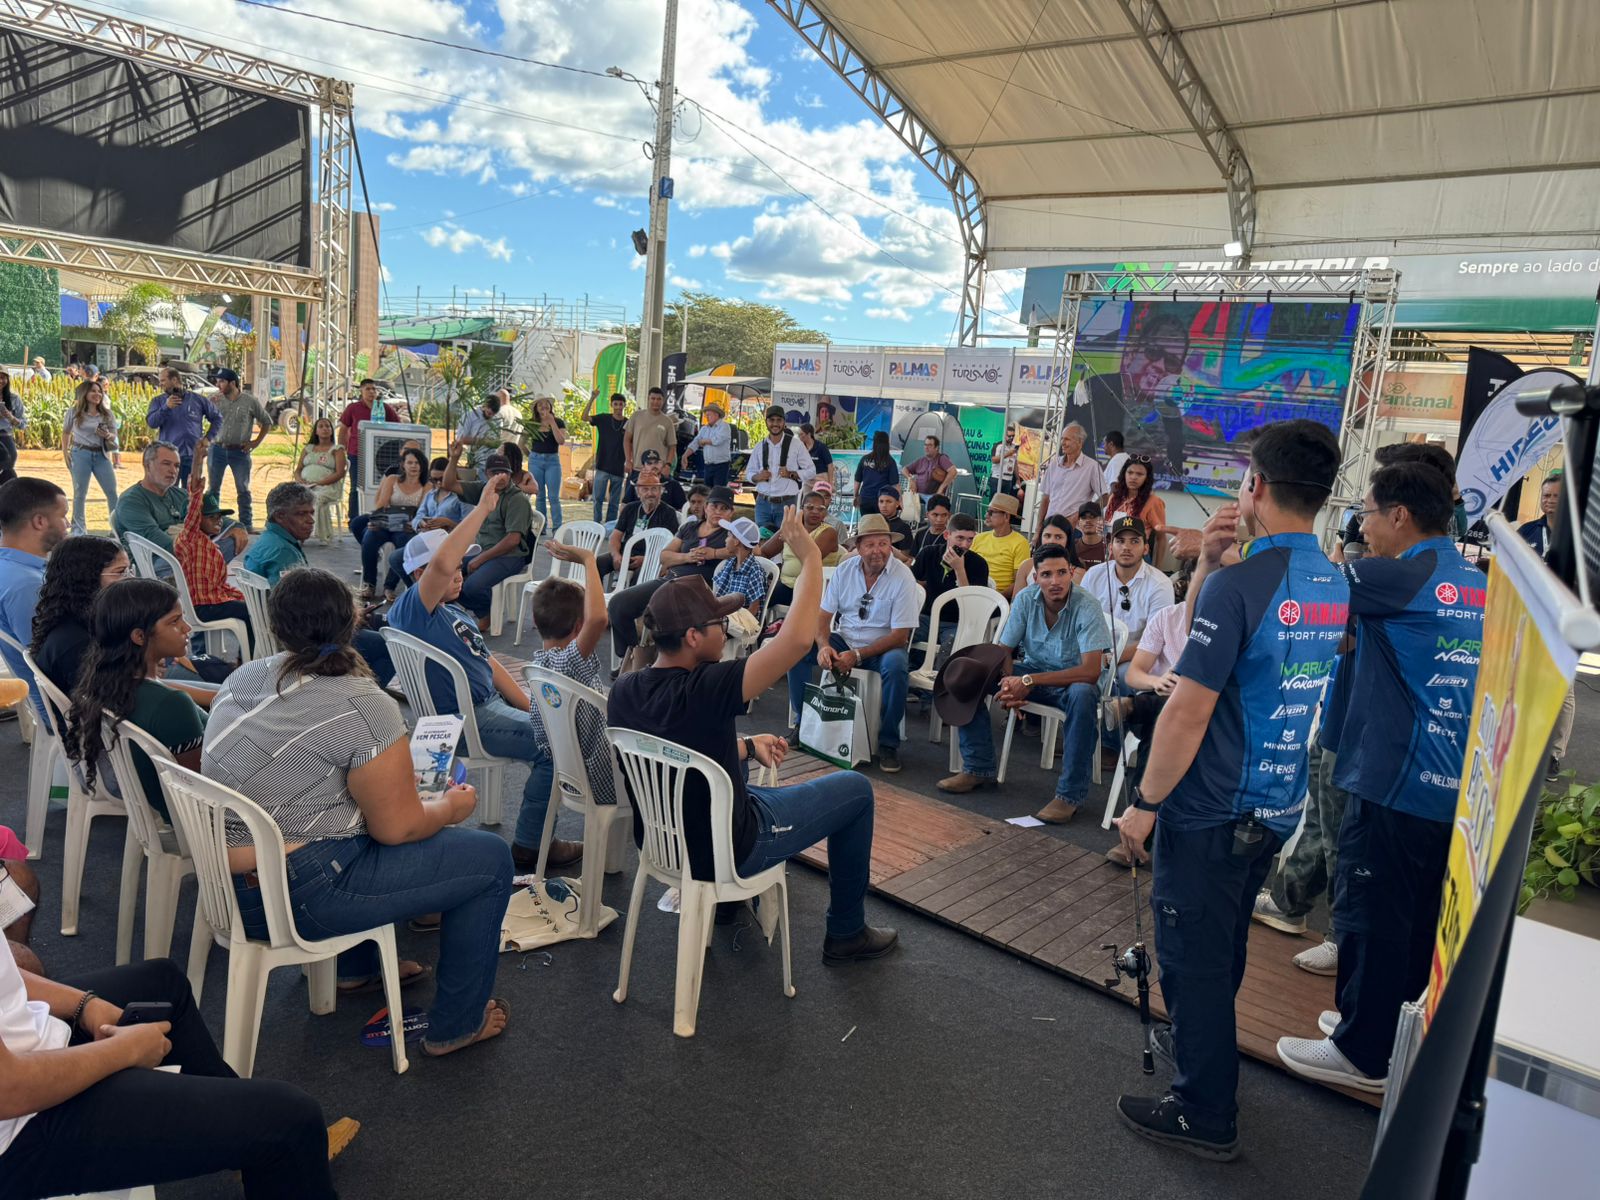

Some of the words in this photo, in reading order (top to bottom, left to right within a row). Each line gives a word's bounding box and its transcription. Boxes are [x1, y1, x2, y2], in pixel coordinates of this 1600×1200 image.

[1458, 261, 1519, 276] Sempre
[1523, 262, 1543, 273] ao
[1547, 258, 1583, 272] lado
[1588, 258, 1600, 272] d
[779, 358, 822, 371] PALMAS
[833, 363, 875, 379] TURISMO
[889, 362, 938, 377] PALMAS
[952, 368, 1002, 384] TURISMO
[1019, 364, 1068, 381] PALM
[1382, 393, 1454, 409] antanal
[1436, 609, 1478, 620] SPORT
[1277, 631, 1316, 641] SPORT
[1436, 635, 1483, 654] MAR
[429, 733, 452, 741] PESCAR
[1263, 741, 1287, 750] MINN
